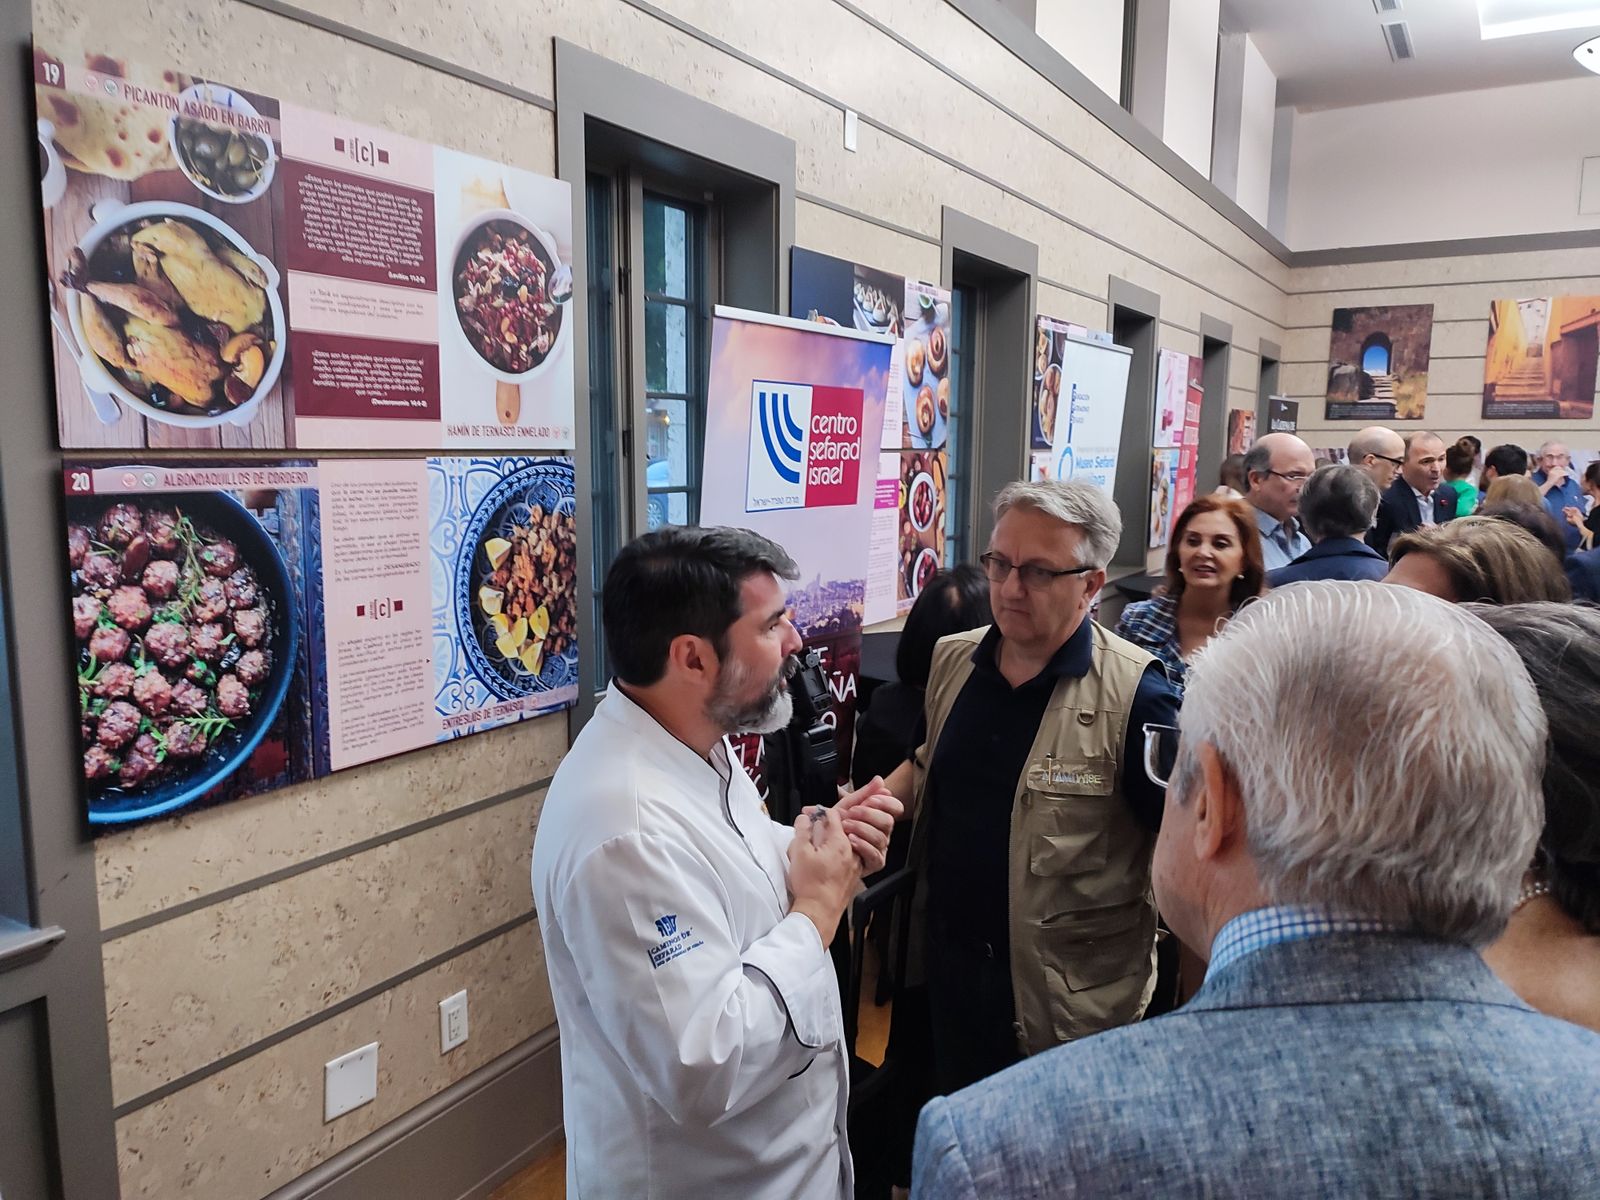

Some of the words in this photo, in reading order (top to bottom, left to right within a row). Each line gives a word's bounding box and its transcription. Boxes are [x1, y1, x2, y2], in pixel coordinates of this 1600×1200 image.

[42, 61, 60, 86] 19
[184, 102, 218, 122] ASADO
[221, 108, 235, 126] EN
[237, 112, 271, 135] BARRO
[472, 425, 480, 437] DE
[811, 412, 858, 435] centro
[809, 435, 861, 461] sefarad
[71, 472, 90, 491] 20
[253, 471, 264, 485] DE
[267, 471, 309, 485] CORDERO
[808, 461, 844, 486] israel
[483, 708, 492, 720] DE
[493, 700, 525, 717] TERNASCO
